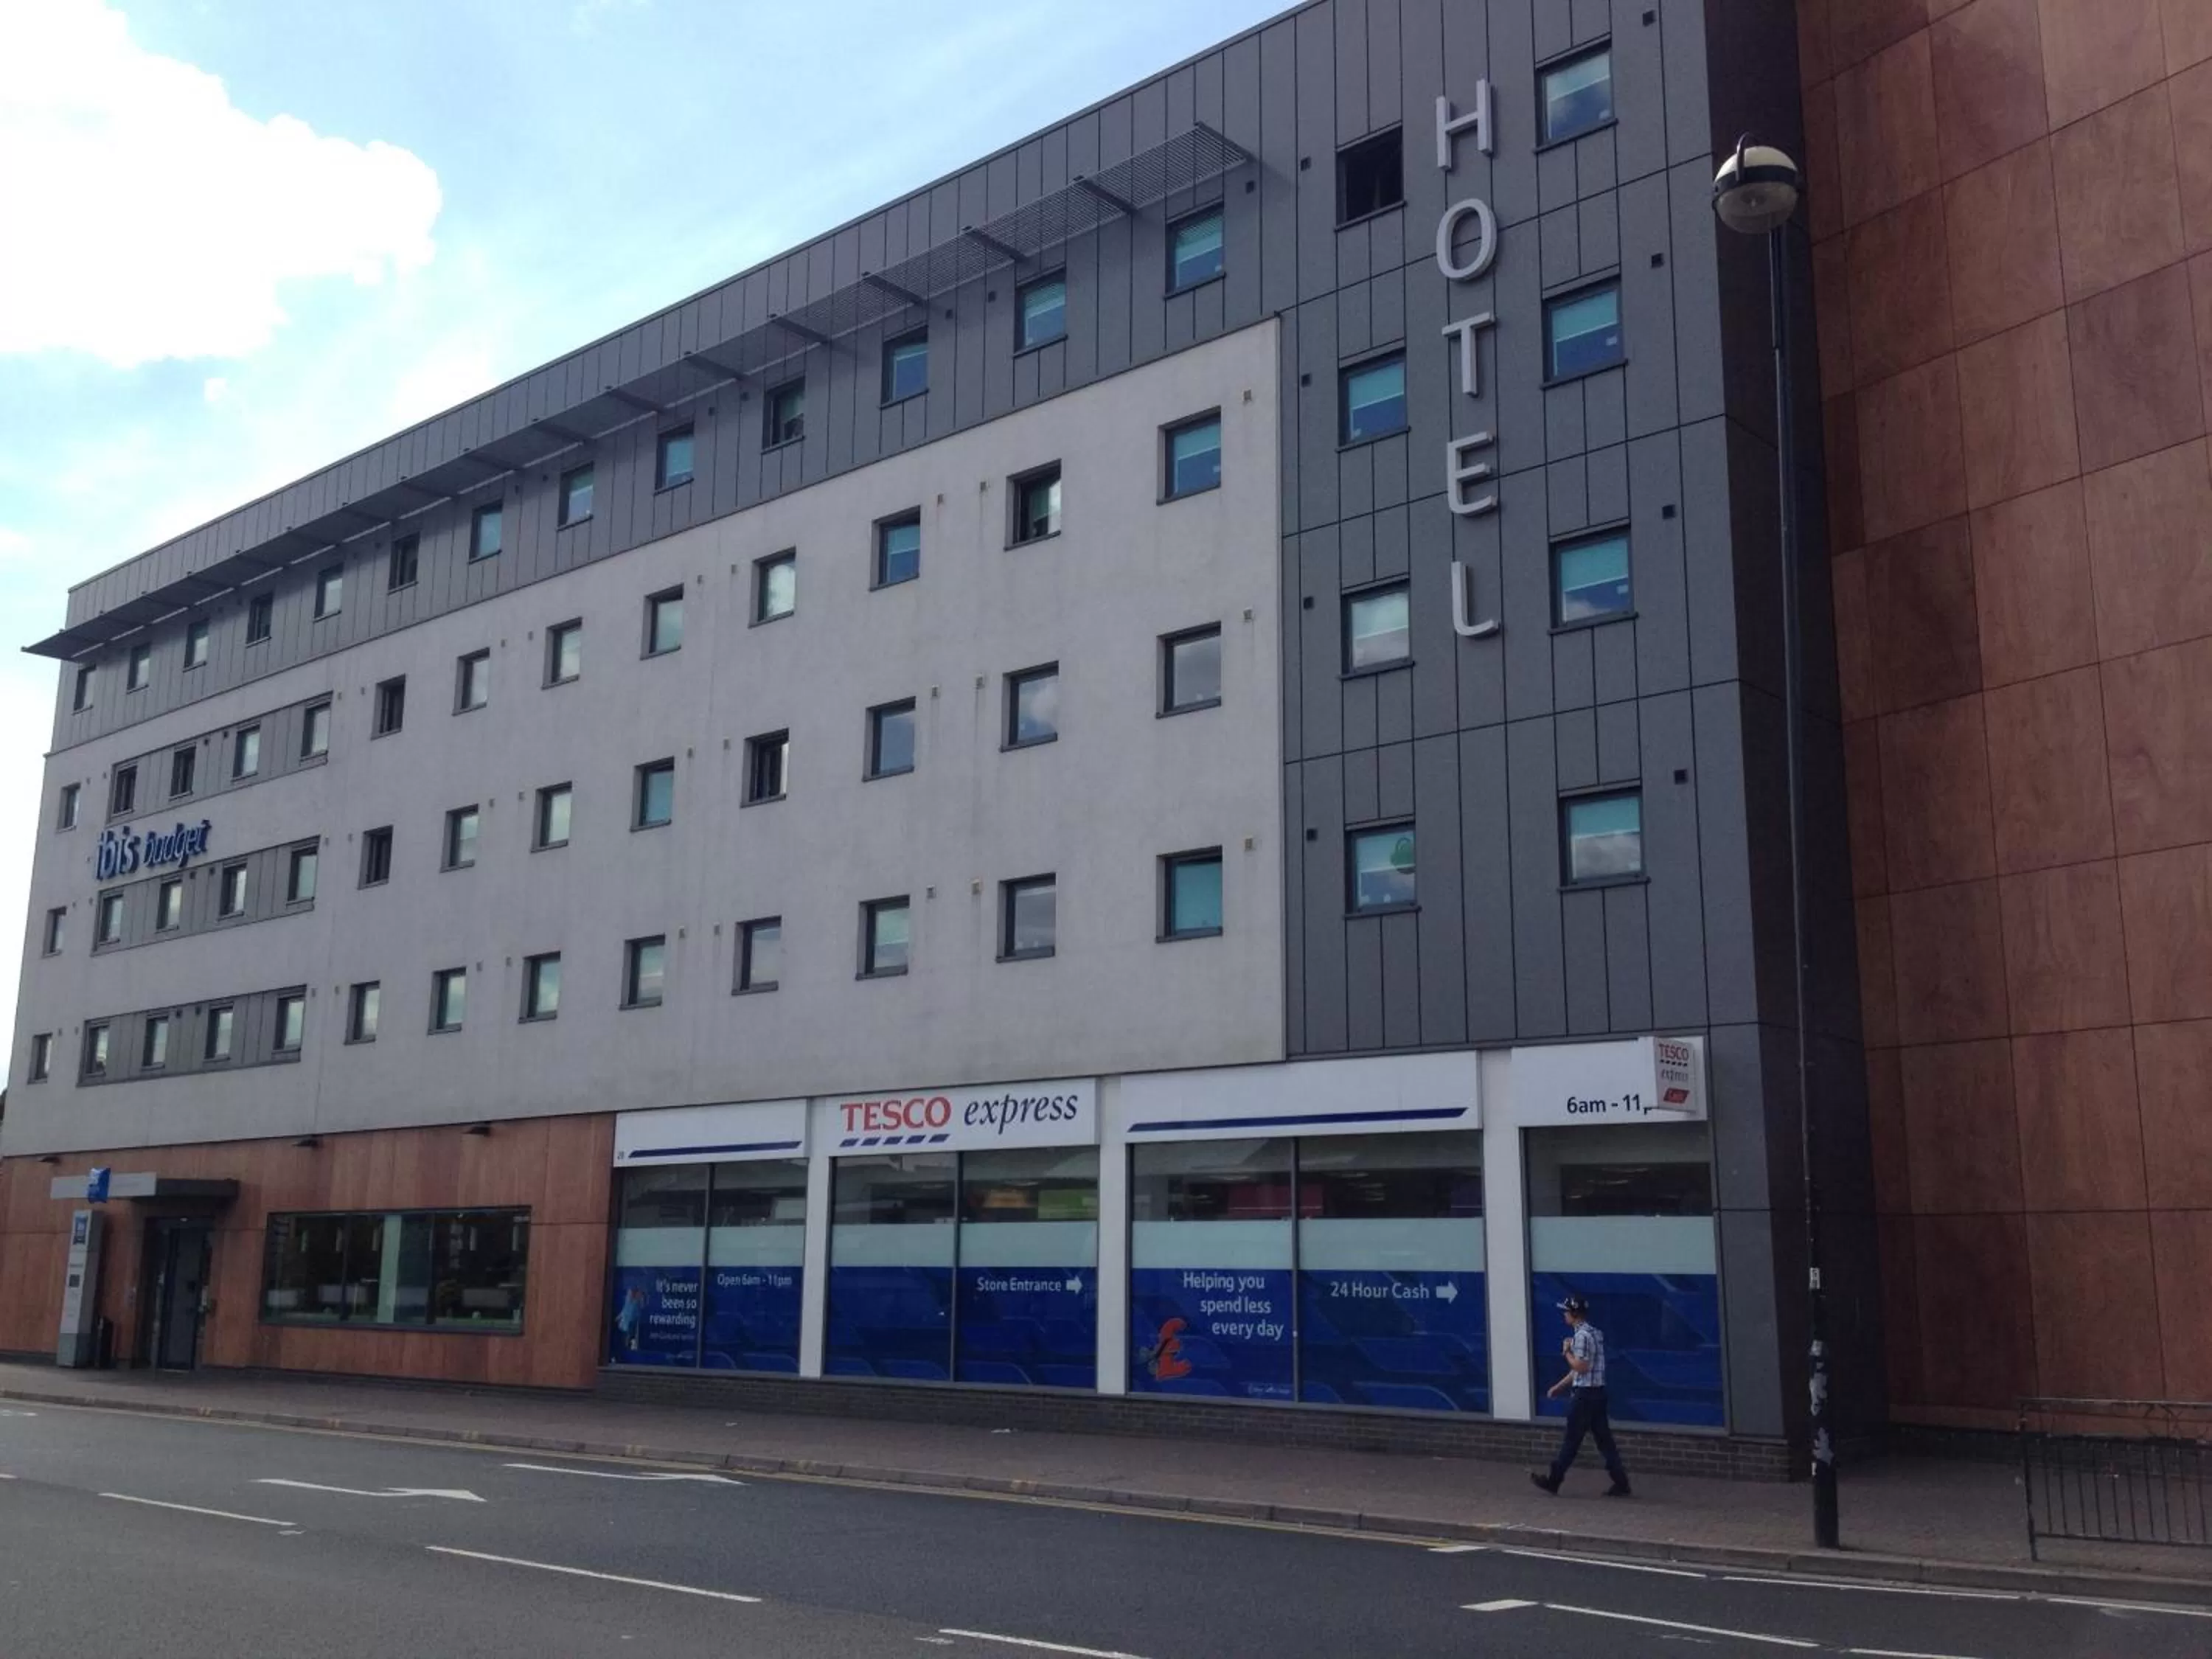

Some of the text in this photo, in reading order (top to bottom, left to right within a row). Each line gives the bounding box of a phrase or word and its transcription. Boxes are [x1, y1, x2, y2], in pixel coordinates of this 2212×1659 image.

[1435, 78, 1501, 637] HOTEL
[97, 819, 212, 880] ibis budget
[1658, 1043, 1689, 1061] TESCO
[839, 1093, 1079, 1135] TESCO express
[1567, 1096, 1607, 1114] 6am
[655, 1279, 699, 1293] It's never
[717, 1273, 741, 1288] Open
[742, 1273, 761, 1287] 6am
[768, 1274, 793, 1287] 11pm
[976, 1276, 1062, 1293] Store Entrance
[1183, 1270, 1265, 1293] Helping you
[1330, 1281, 1430, 1299] 24 Hour Cash
[661, 1298, 697, 1310] been so
[1200, 1295, 1272, 1316] spend less
[649, 1312, 697, 1329] rewarding
[1211, 1318, 1284, 1341] every day
